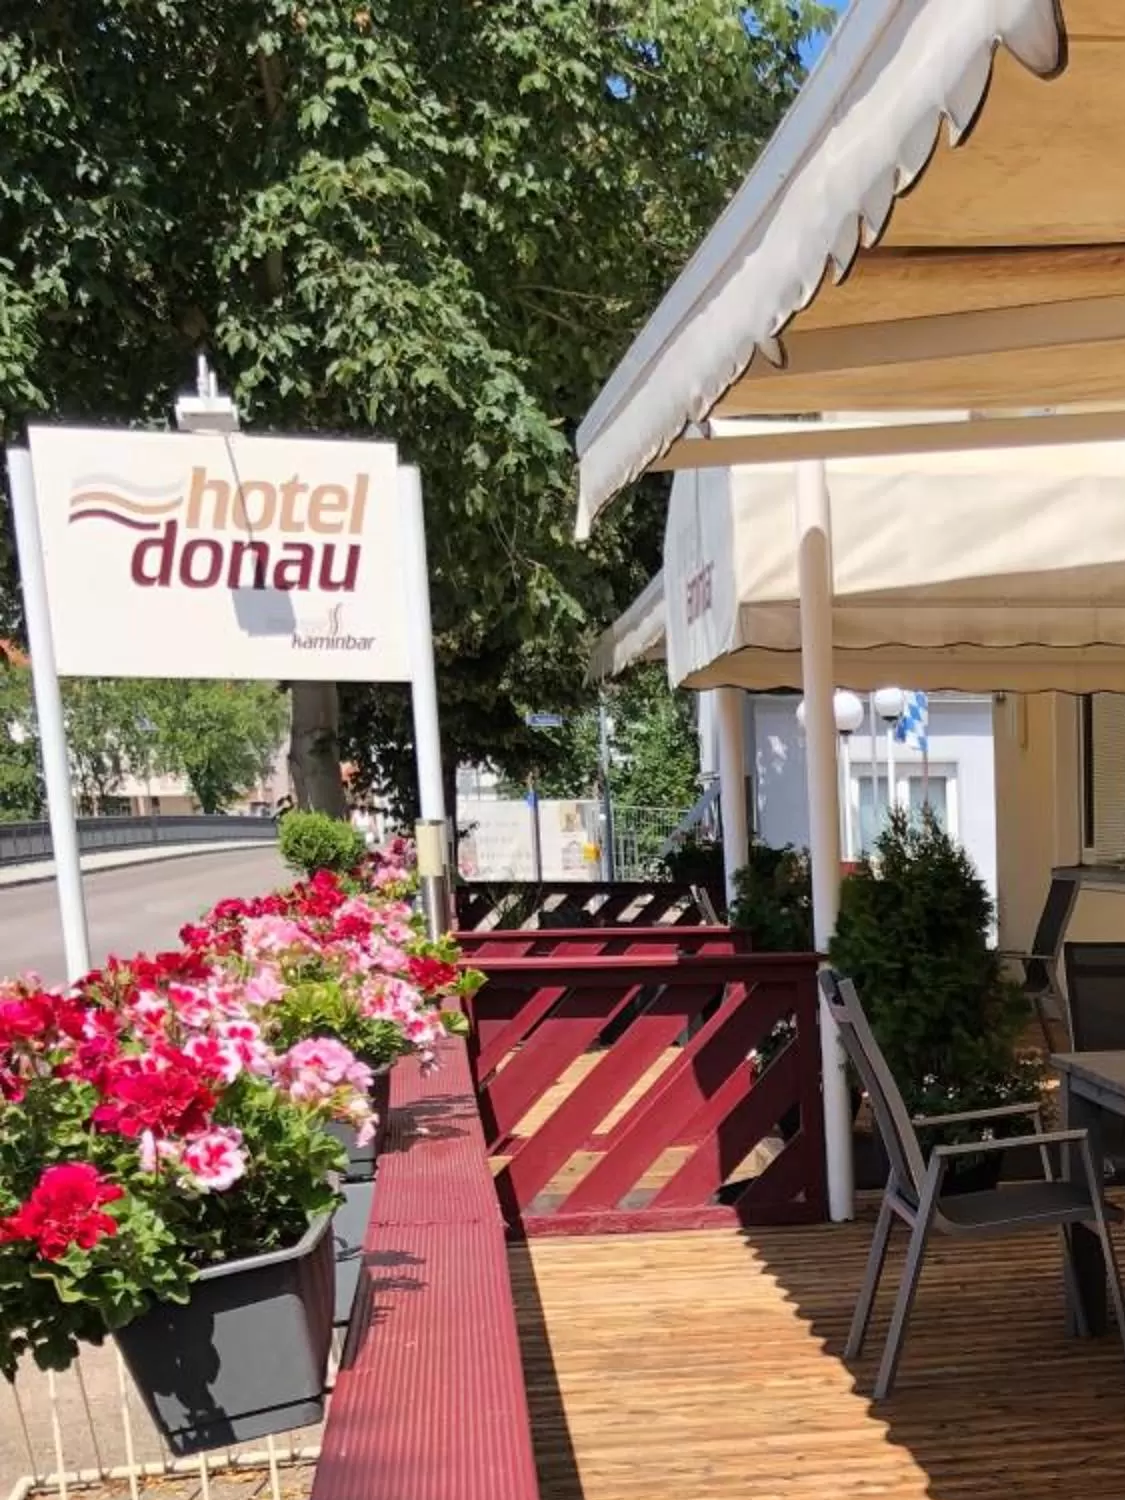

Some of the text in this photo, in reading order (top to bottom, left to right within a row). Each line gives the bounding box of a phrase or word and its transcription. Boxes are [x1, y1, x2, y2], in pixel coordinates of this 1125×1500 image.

[185, 466, 370, 535] hotel
[131, 519, 361, 591] donau
[291, 632, 376, 650] kaminbar
